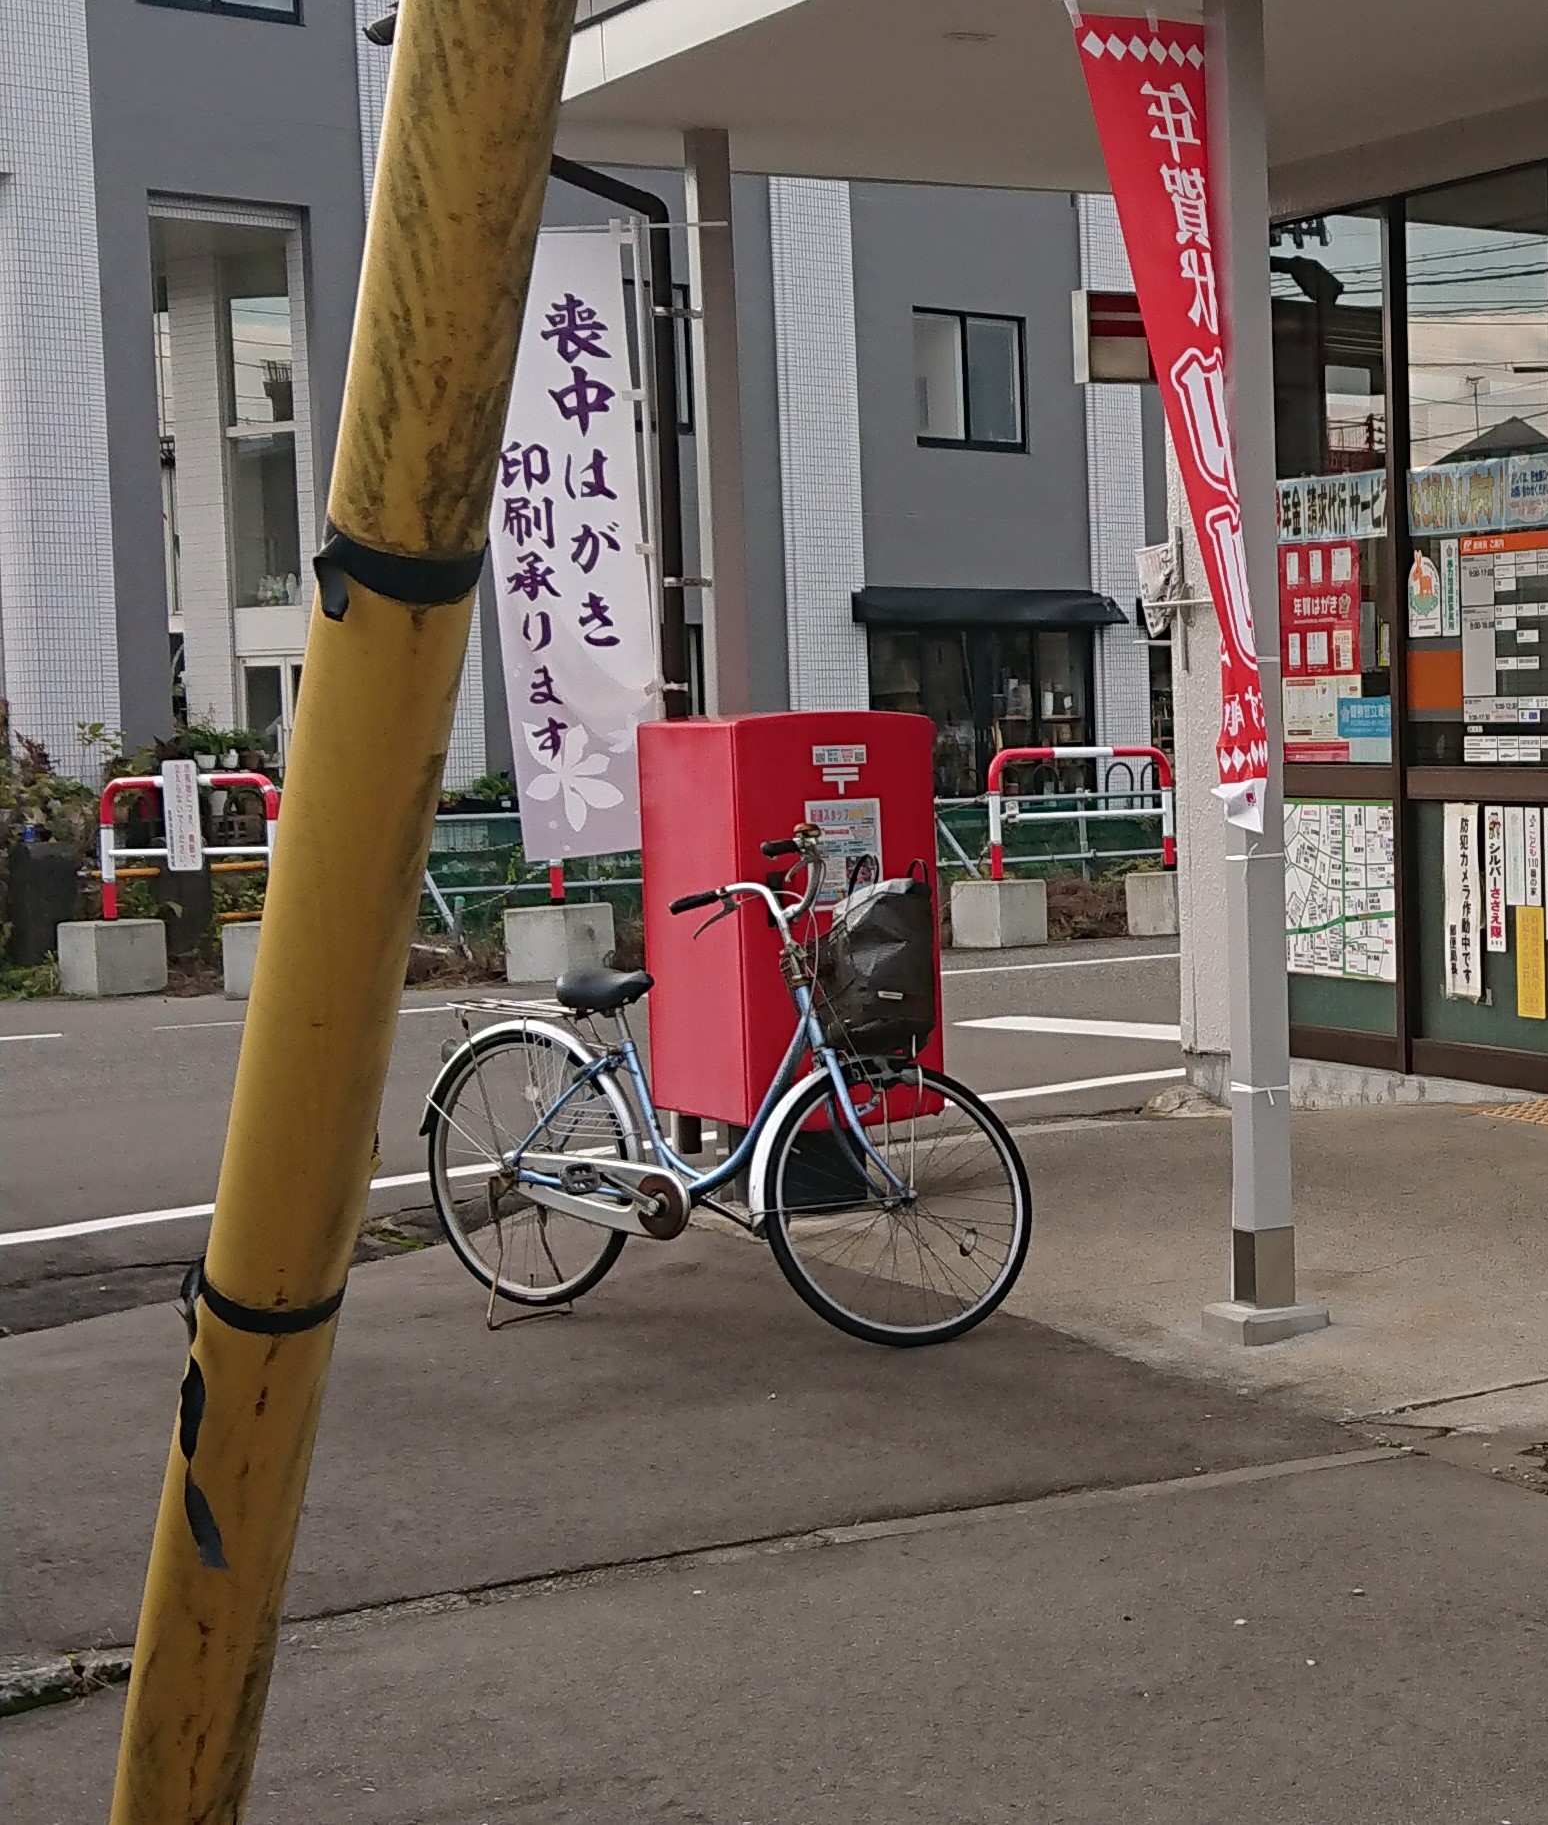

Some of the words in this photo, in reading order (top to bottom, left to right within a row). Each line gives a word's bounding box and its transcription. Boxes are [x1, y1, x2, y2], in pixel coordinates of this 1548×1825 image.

[540, 292, 622, 649] 喪中はがき
[500, 439, 568, 760] 印刷承ります
[1293, 596, 1338, 615] 年賀はがき
[1449, 924, 1458, 976] 郵便局長
[1460, 817, 1472, 985] 防犯カメラ作動中です
[1489, 842, 1502, 939] シルバーささえ隊
